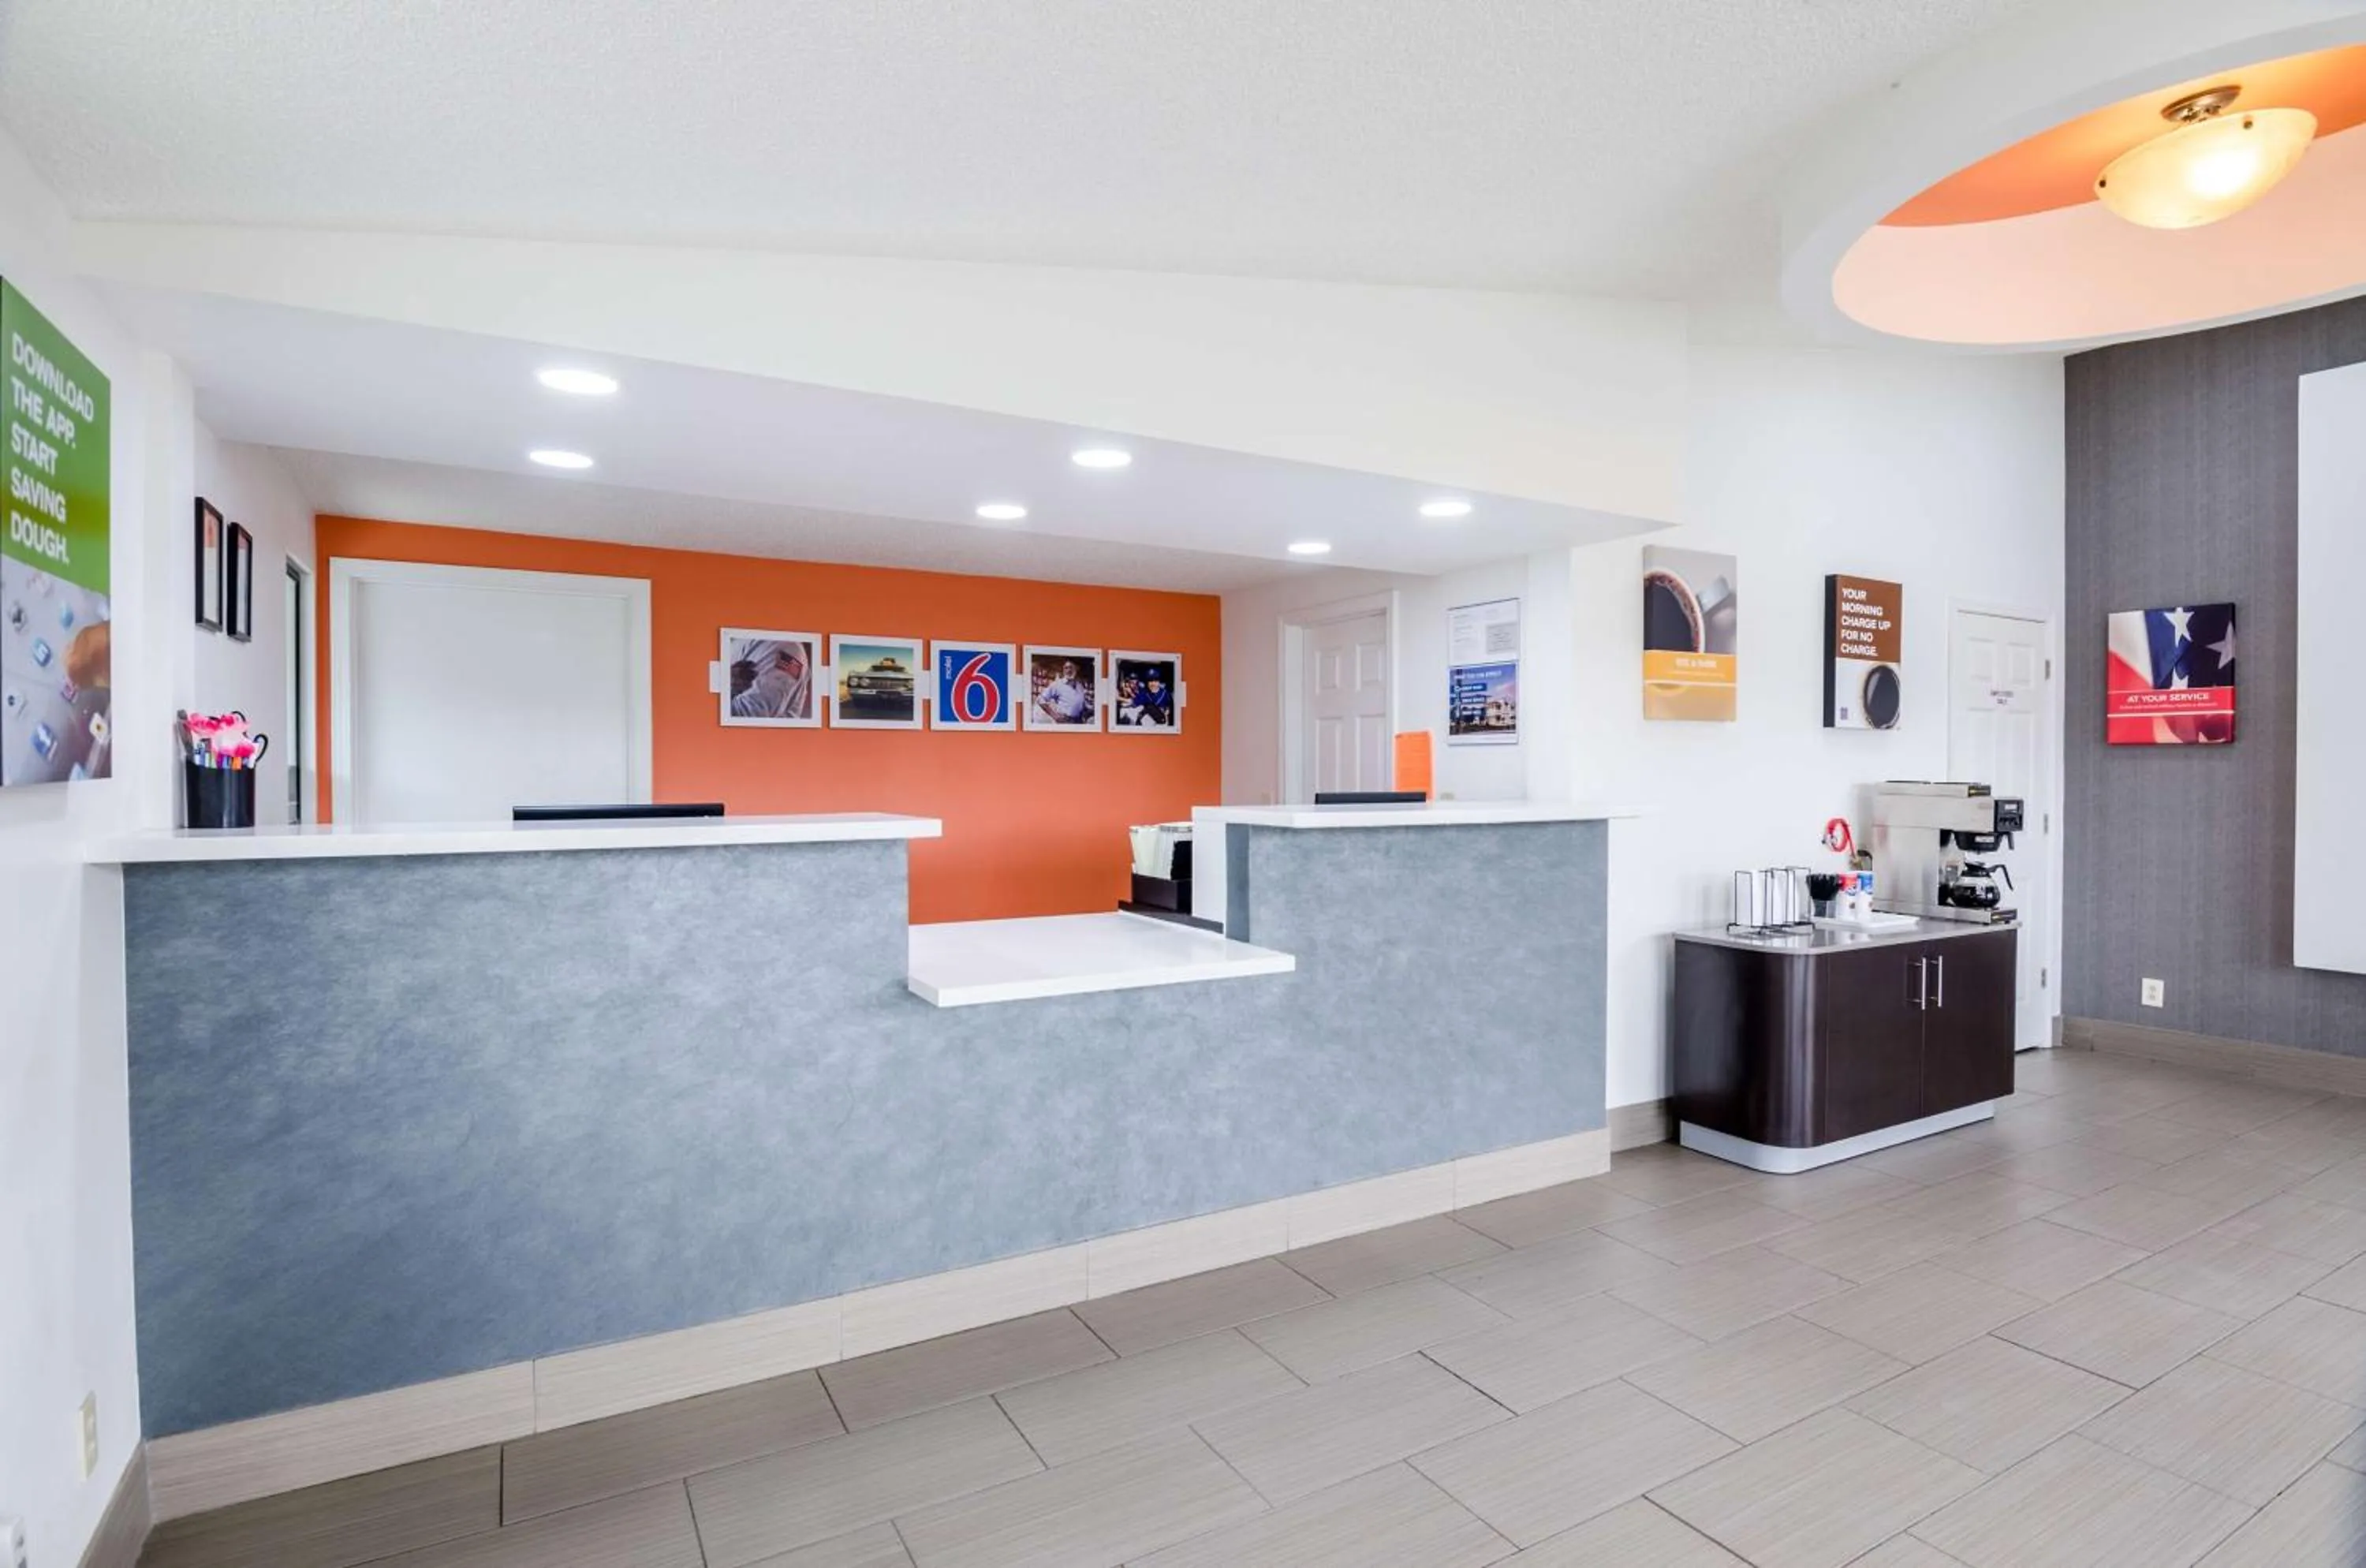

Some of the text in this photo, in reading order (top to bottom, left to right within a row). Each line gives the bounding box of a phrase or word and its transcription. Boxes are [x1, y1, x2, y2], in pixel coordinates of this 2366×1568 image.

[12, 332, 95, 423] DOWNLOAD
[11, 375, 77, 449] THE APP.
[11, 420, 58, 476] START
[11, 466, 66, 525] SAVING
[11, 511, 70, 565] DOUGH.
[1842, 588, 1868, 600] YOUR
[1842, 602, 1883, 616] MORNING
[1841, 615, 1892, 631] CHARGE UP
[1841, 629, 1874, 643] FOR NO
[1840, 642, 1879, 656] CHARGE.
[950, 652, 1001, 723] 6
[2127, 695, 2140, 704] AT
